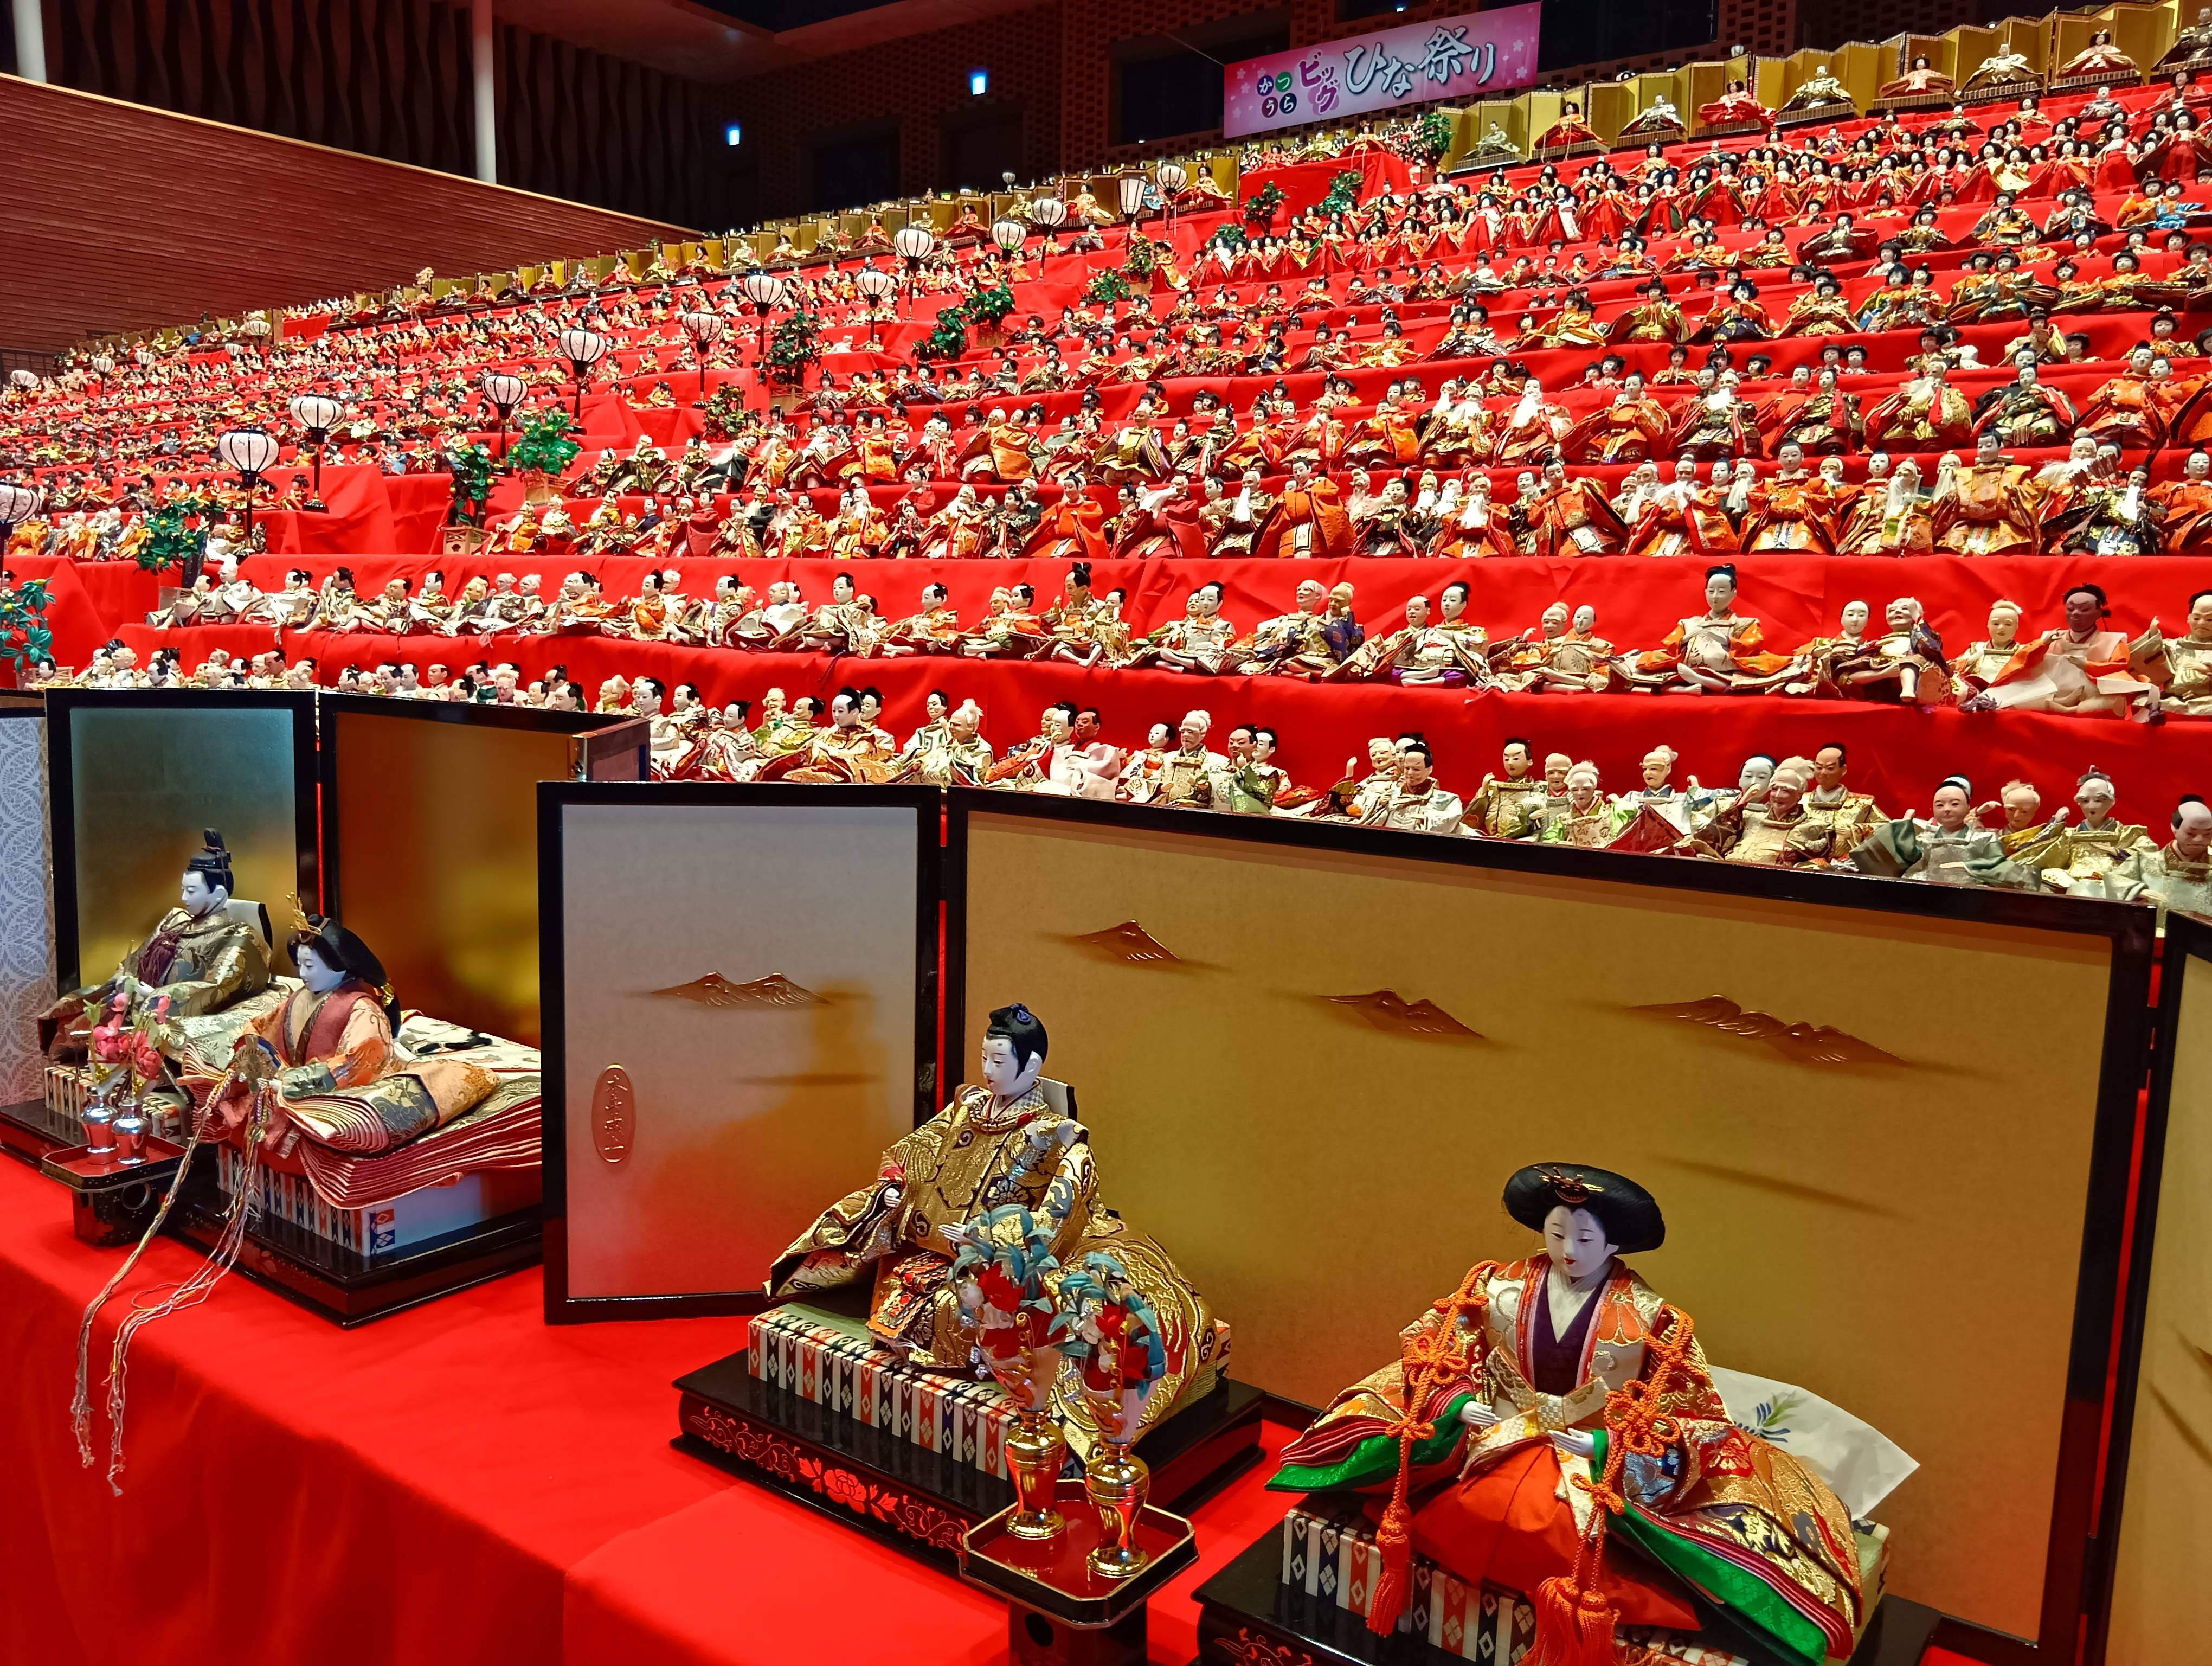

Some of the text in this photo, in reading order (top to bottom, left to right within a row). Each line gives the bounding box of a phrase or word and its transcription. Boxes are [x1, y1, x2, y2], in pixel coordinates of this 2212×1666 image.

[1299, 25, 1495, 113] ビッグ ひな祭り
